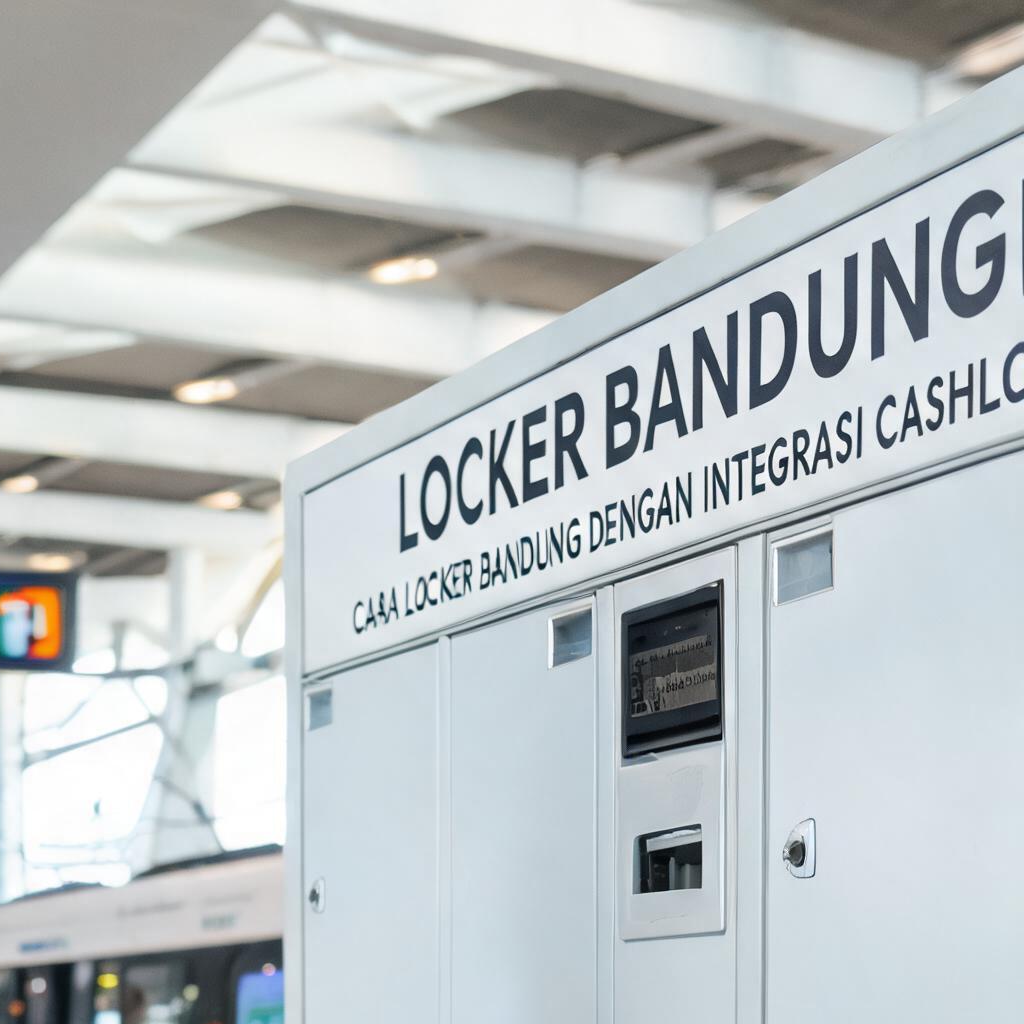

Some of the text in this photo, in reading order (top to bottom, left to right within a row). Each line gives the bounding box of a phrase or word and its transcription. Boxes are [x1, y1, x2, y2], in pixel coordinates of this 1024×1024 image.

[399, 180, 1024, 554] LOCKER BANDUNG
[404, 558, 473, 617] LOCKER
[479, 517, 582, 591] BANDUNG
[589, 471, 693, 554] DENGAN
[703, 406, 863, 513] INTEGRASI
